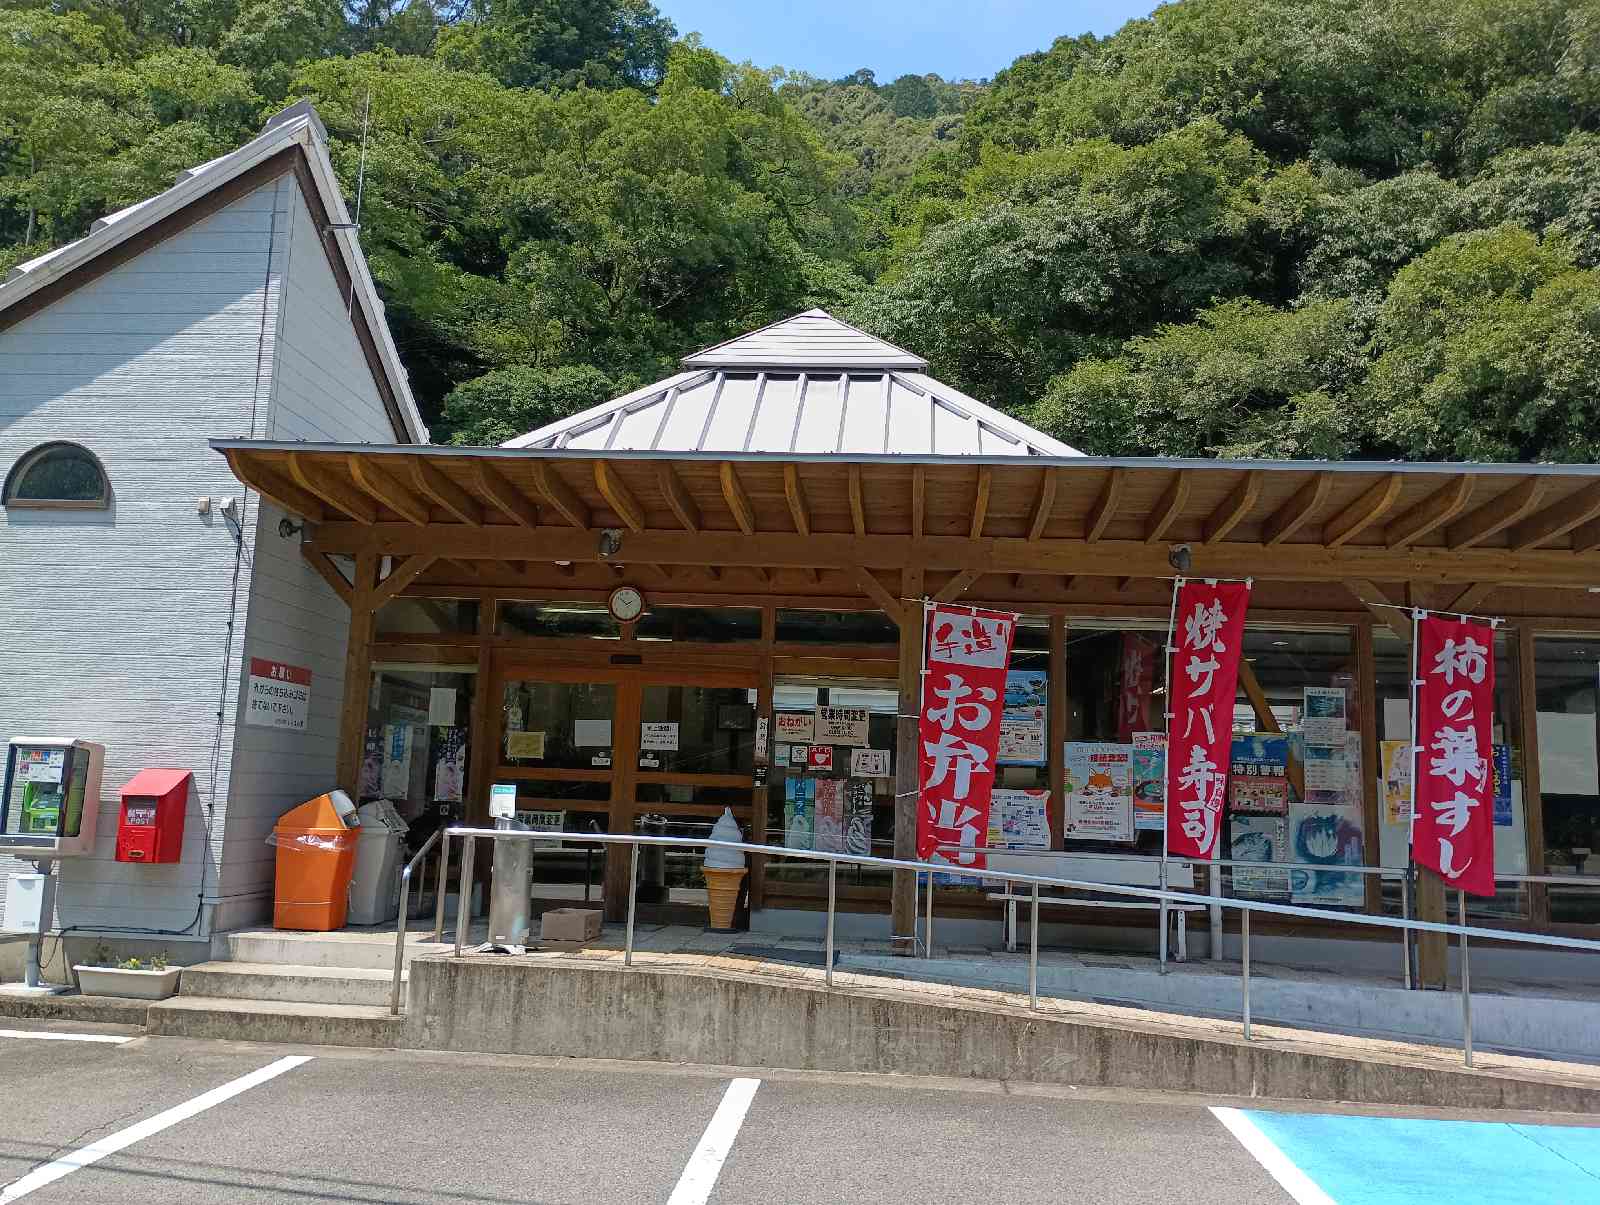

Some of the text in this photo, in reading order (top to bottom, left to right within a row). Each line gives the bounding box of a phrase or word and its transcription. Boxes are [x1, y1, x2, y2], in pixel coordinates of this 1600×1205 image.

[779, 716, 811, 727] おねがい
[821, 708, 865, 721] 営業時間変更
[923, 673, 998, 866] お弁当
[1178, 598, 1227, 854] 焼サバ寿司
[1429, 636, 1488, 879] 柿の葉すし
